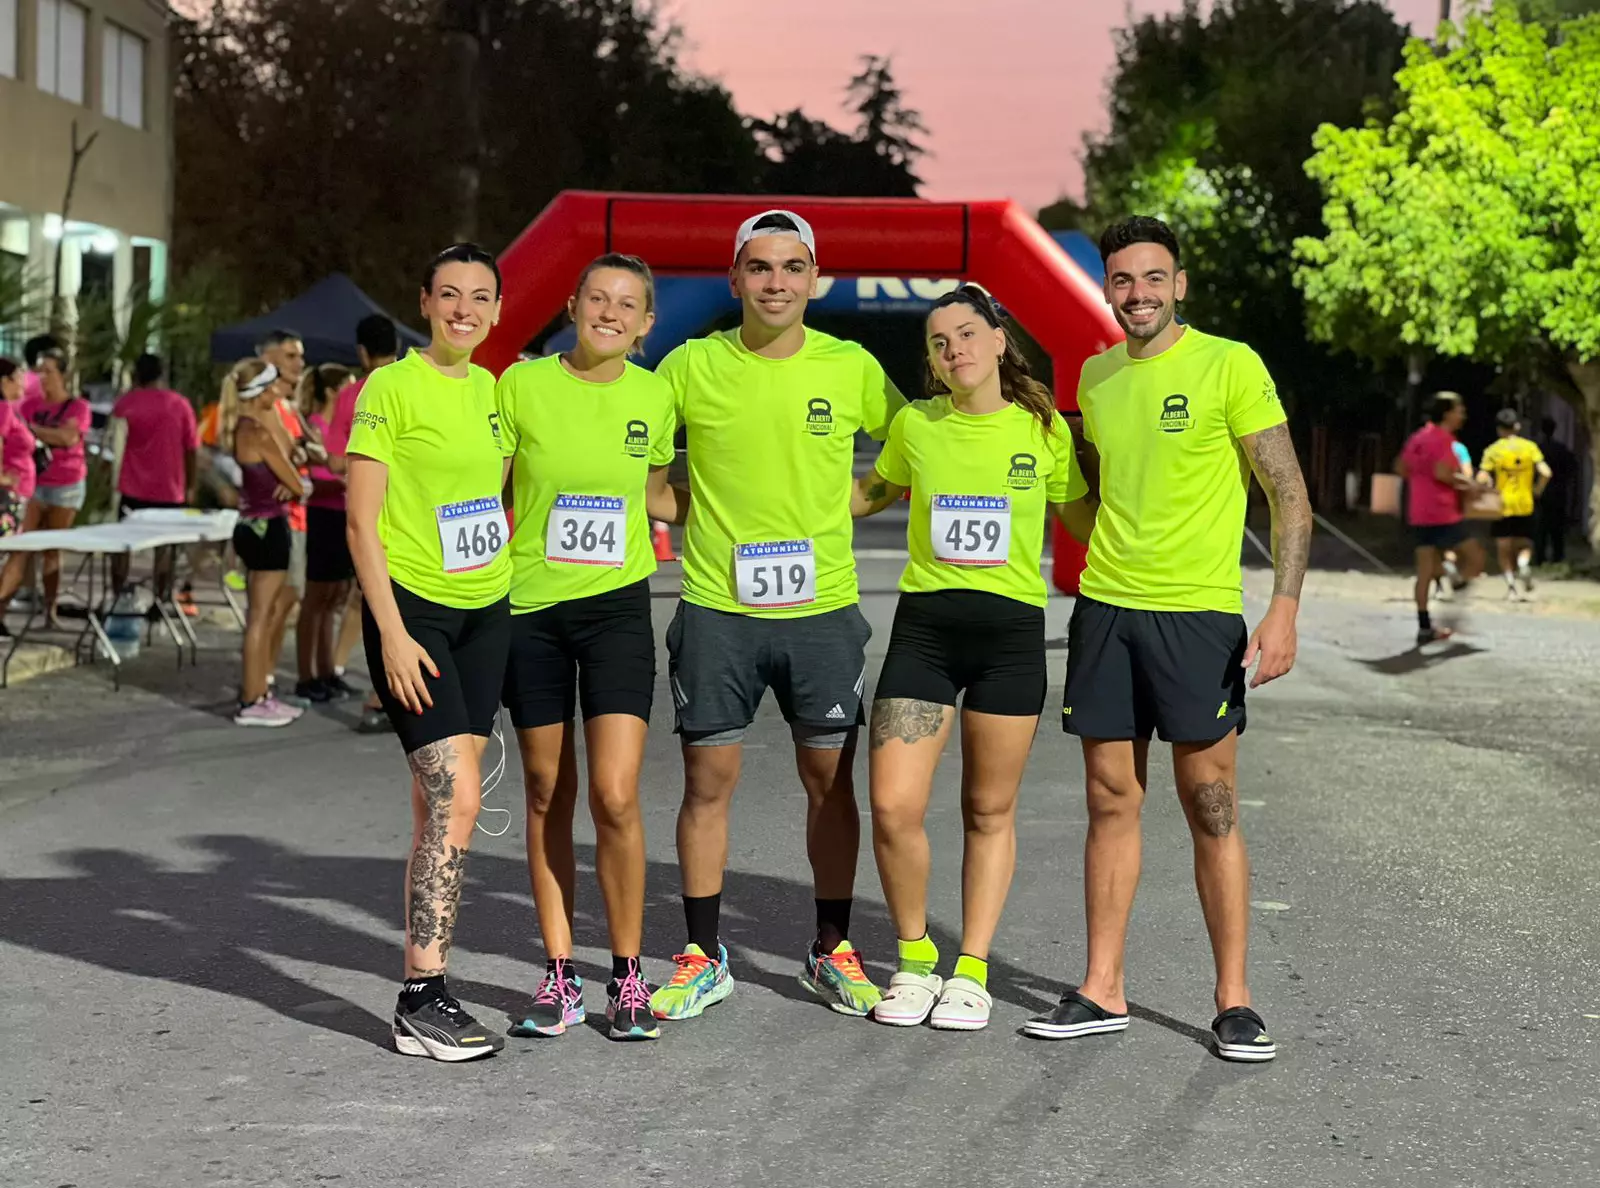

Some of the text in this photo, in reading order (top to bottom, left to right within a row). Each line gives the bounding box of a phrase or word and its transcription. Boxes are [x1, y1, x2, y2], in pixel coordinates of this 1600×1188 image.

[809, 414, 831, 422] ALBERTI
[1163, 410, 1187, 419] ALBERTI
[806, 423, 832, 431] FUNCIONAL
[1160, 419, 1189, 428] FUNCIONAL
[1010, 468, 1035, 477] ALBERTI
[557, 498, 620, 509] ATRUNNING
[940, 498, 1004, 508] ATRUNNING
[443, 501, 497, 517] ATRUNNING
[456, 520, 502, 559] 468
[560, 518, 616, 553] 364
[945, 519, 1001, 552] 459
[743, 544, 806, 556] ATRUNNING
[752, 563, 806, 598] 519
